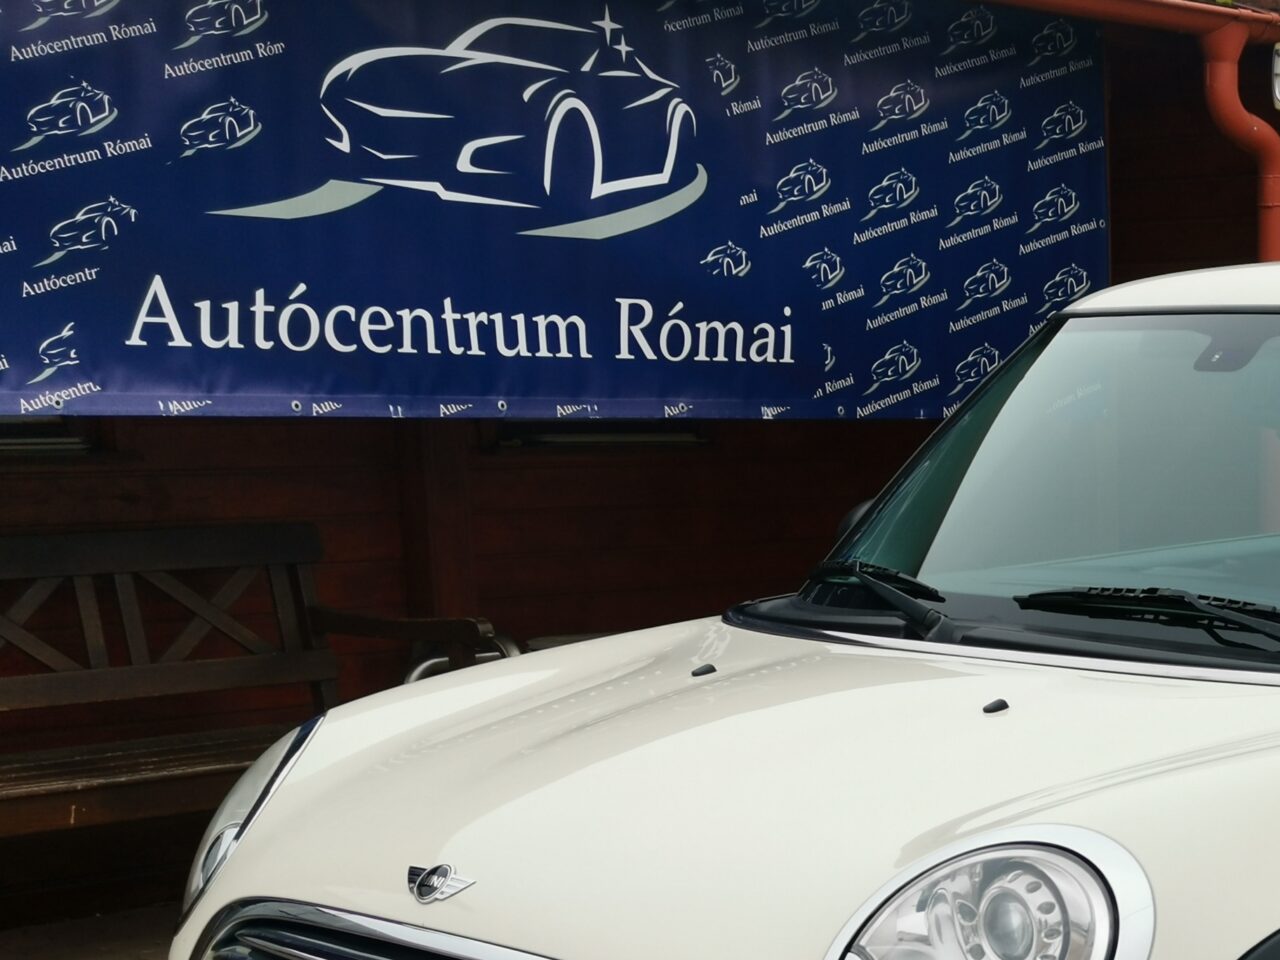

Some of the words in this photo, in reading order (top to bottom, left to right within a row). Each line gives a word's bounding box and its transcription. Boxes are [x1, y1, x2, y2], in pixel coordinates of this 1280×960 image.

[10, 31, 108, 62] Autócentrum
[108, 18, 157, 40] Római
[164, 49, 254, 79] Autócentrum
[765, 118, 828, 146] Autócentrum
[829, 107, 860, 127] Római
[861, 130, 919, 155] Autócentrum
[920, 117, 948, 136] Római
[948, 138, 1001, 164] Autócentrum
[1002, 127, 1027, 146] Római
[0, 149, 102, 182] Autócentrum
[103, 133, 152, 158] Római
[1026, 148, 1077, 172] Autócentrum
[1078, 136, 1105, 154] Római
[759, 210, 820, 238] Autócentrum
[821, 197, 851, 218] Római
[852, 217, 909, 245] Autócentrum
[909, 204, 938, 225] Római
[938, 225, 991, 251] Autócentrum
[992, 211, 1018, 231] Római
[1018, 230, 1070, 256] Autócentrum
[1070, 218, 1097, 236] Római
[835, 284, 865, 306] Római
[865, 302, 919, 331] Autócentrum
[919, 288, 949, 309] Római
[949, 305, 1001, 333] Autócentrum
[1001, 292, 1028, 312] Római
[125, 274, 593, 359] Autócentrum
[613, 297, 796, 364] Római
[824, 372, 855, 394] Római
[856, 387, 912, 419] Autócentrum
[911, 374, 940, 395] Római
